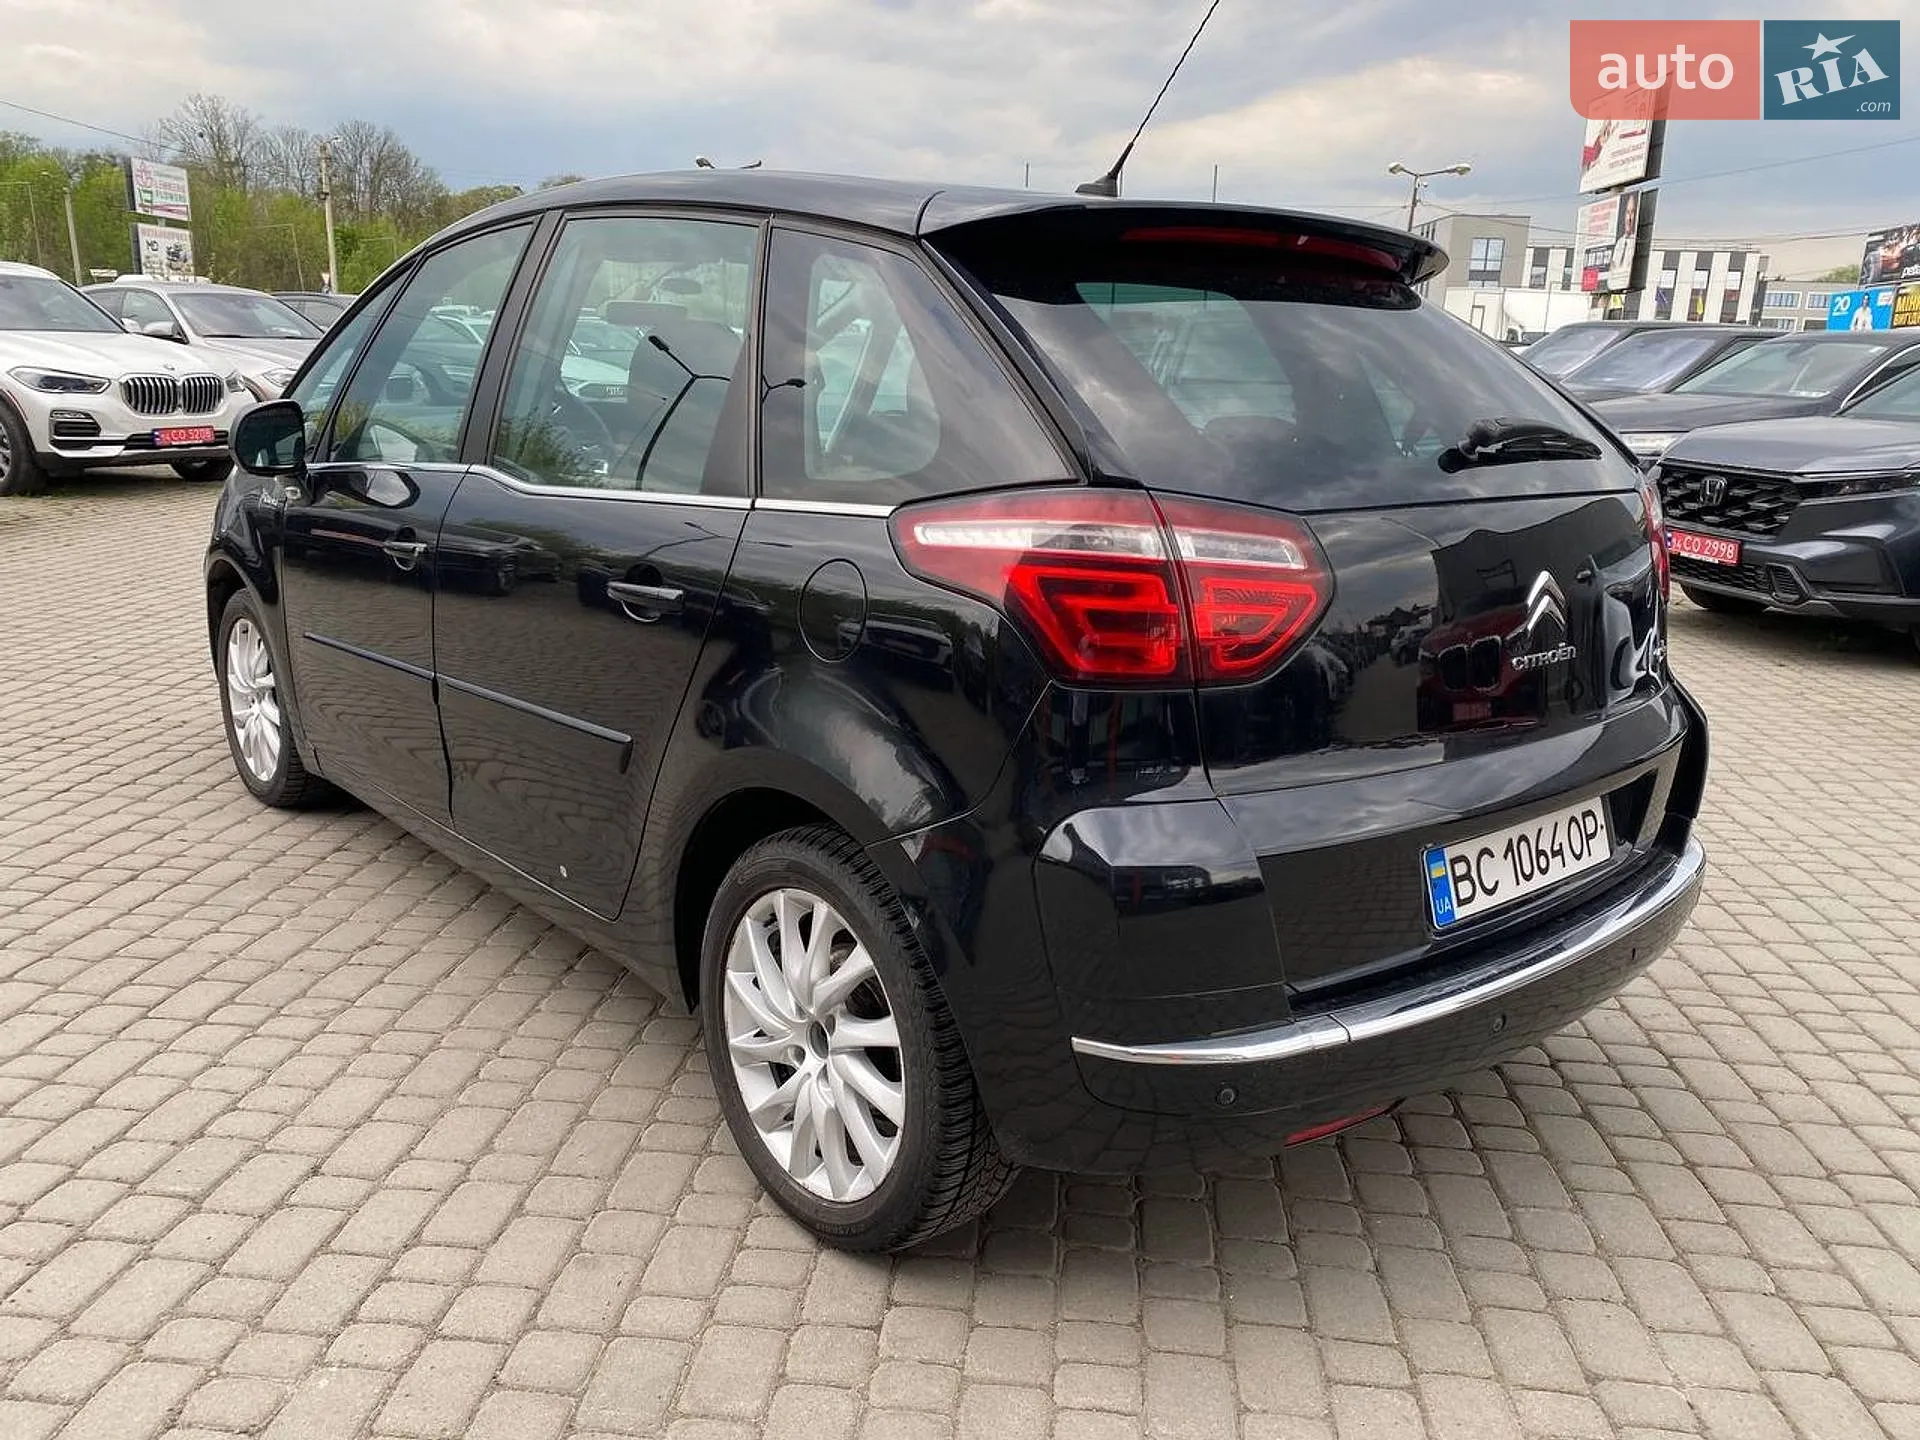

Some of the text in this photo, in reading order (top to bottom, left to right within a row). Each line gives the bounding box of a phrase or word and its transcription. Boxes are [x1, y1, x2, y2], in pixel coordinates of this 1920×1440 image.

[1682, 535, 1700, 552] CO
[1704, 539, 1735, 559] 2998
[1450, 809, 1598, 907] BC 1064 OP
[1436, 897, 1452, 915] UA
